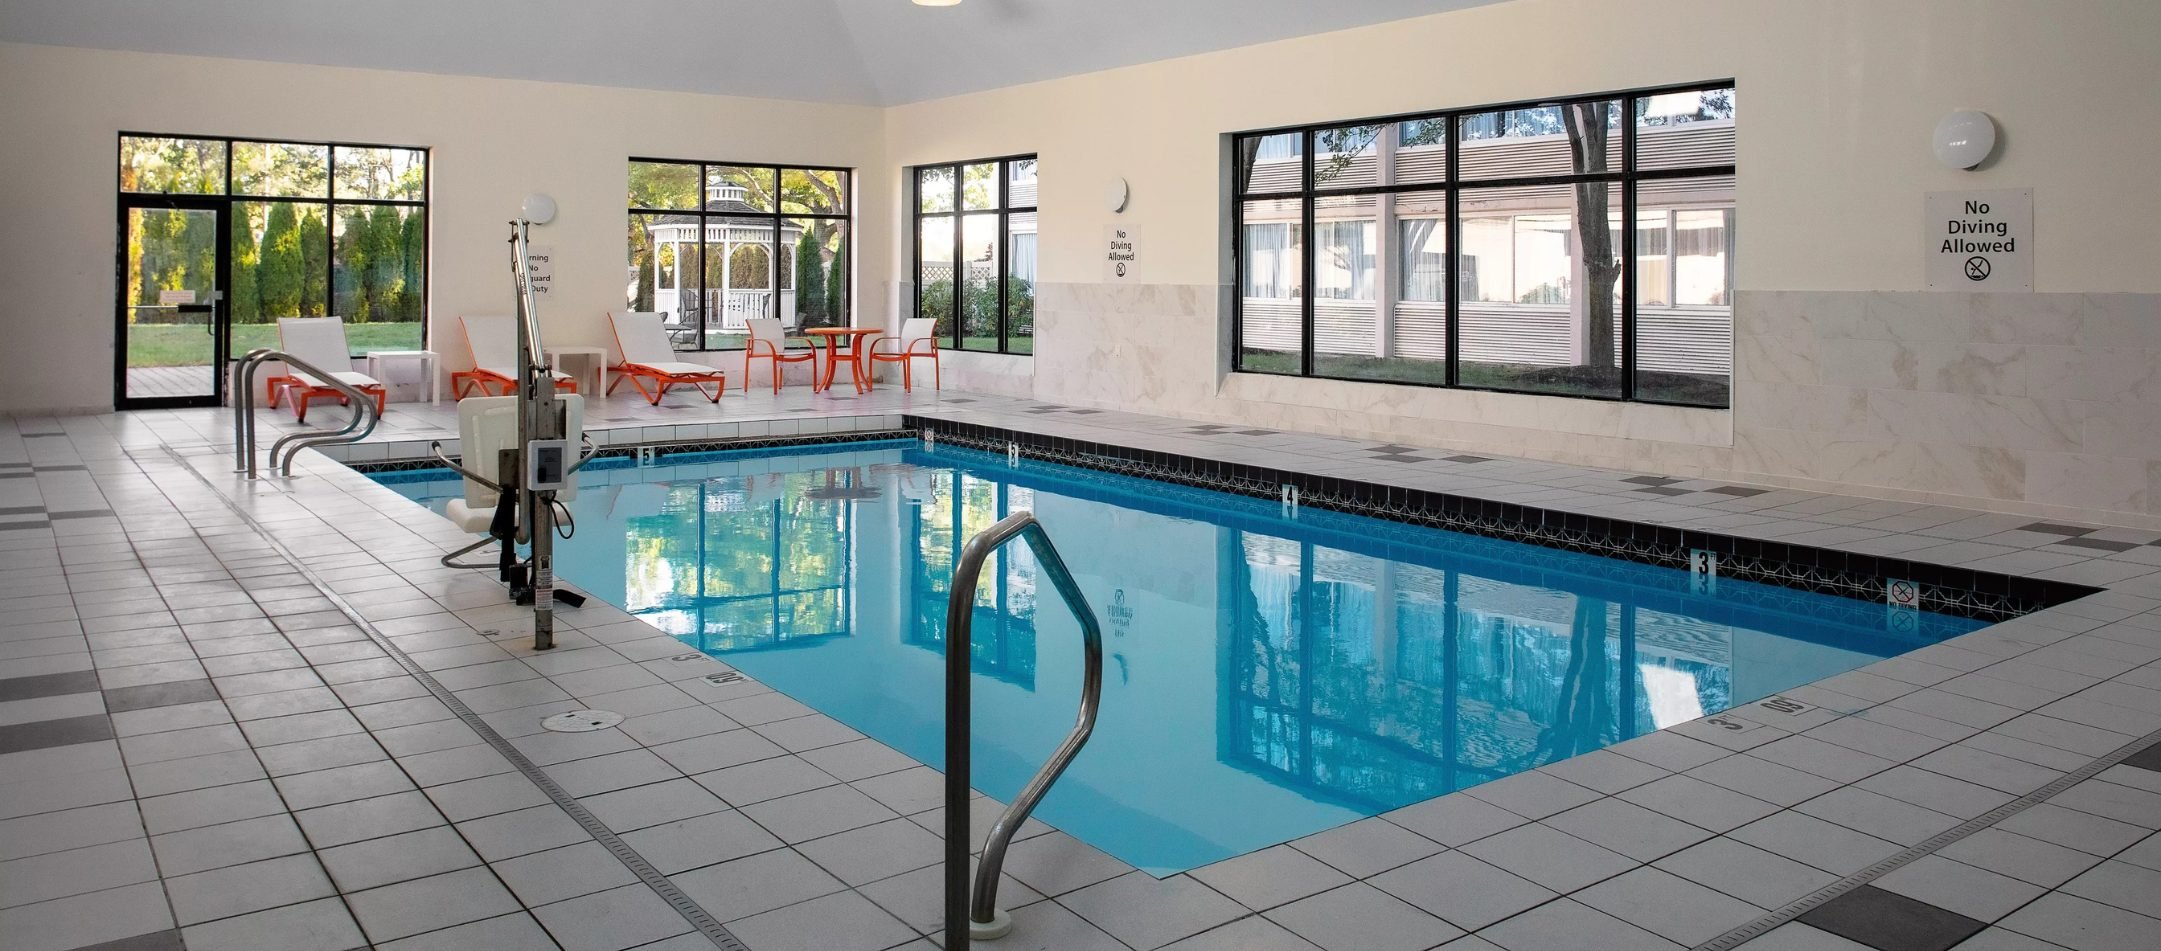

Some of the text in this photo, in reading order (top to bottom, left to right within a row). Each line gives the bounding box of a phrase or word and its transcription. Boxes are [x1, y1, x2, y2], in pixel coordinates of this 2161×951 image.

[1965, 200, 1990, 215] No
[1116, 230, 1126, 239] No
[1948, 219, 2007, 237] Diving
[1110, 241, 1132, 252] Diving
[1941, 237, 2015, 253] Allowed
[529, 254, 549, 263] rning
[1108, 252, 1134, 261] Allowed
[1287, 486, 1293, 505] 4
[1698, 551, 1709, 574] 3
